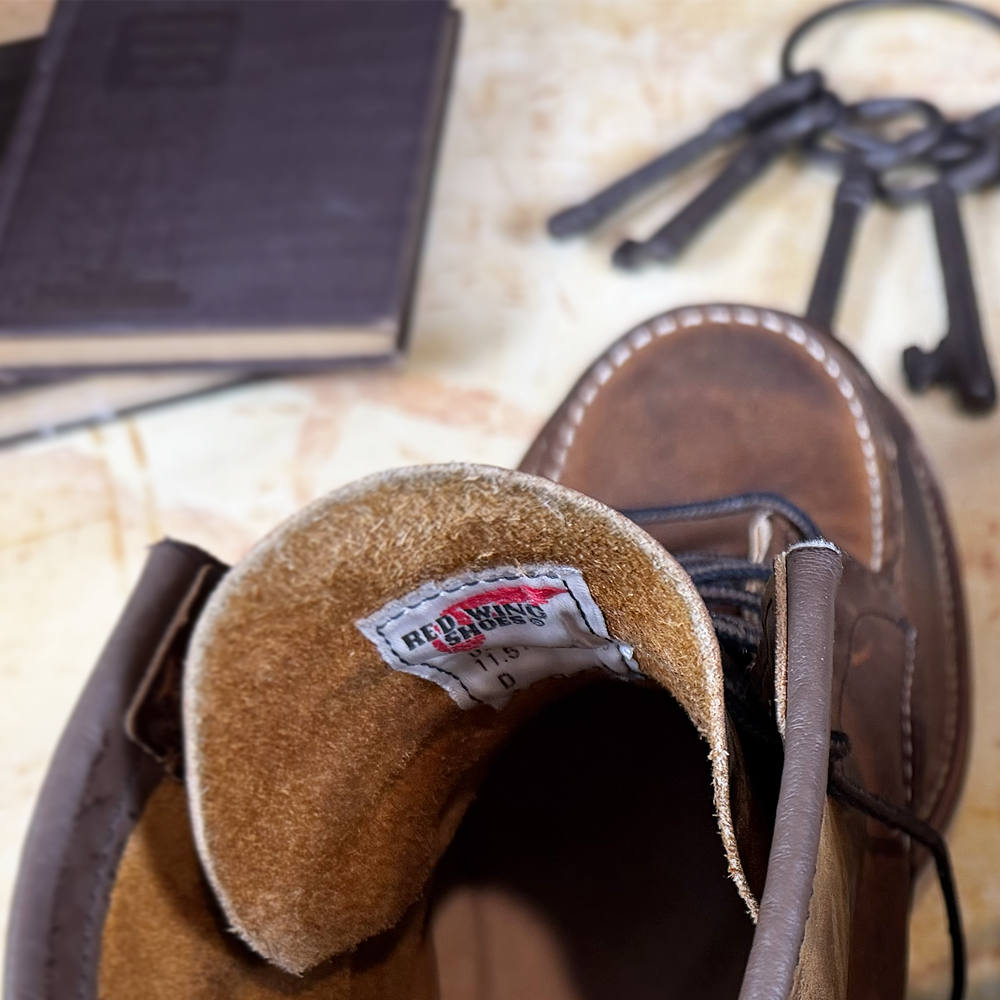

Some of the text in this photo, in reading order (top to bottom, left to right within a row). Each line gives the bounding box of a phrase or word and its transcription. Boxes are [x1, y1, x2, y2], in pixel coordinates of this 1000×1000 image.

[401, 603, 548, 651] RED WING
[475, 647, 520, 672] 11.5
[497, 672, 516, 690] D
